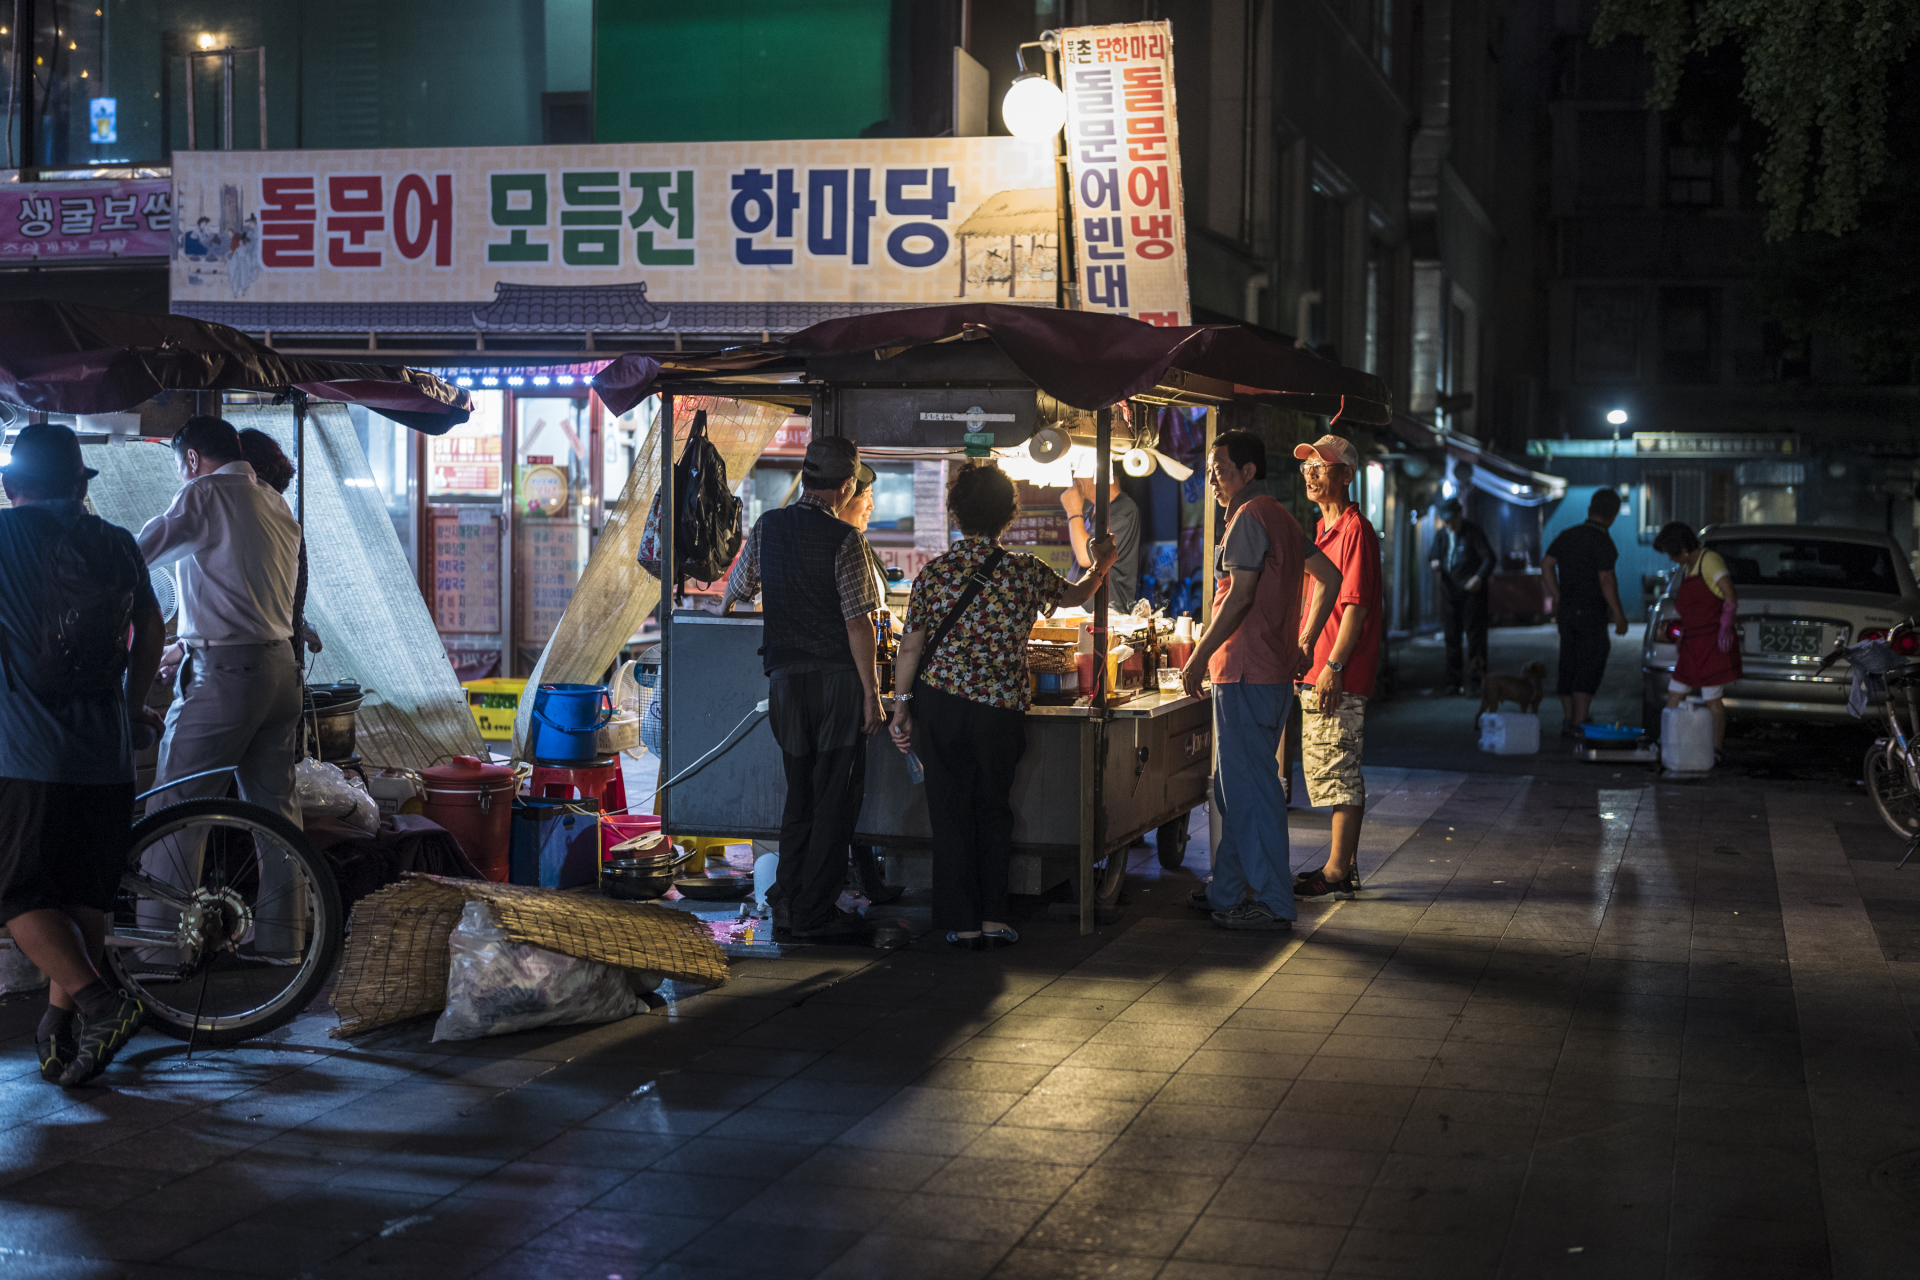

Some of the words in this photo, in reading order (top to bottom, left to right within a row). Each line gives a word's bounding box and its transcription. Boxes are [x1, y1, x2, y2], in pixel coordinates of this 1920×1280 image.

[1096, 34, 1165, 63] 닭한마리
[260, 172, 453, 268] 돌문어
[488, 170, 694, 266] 모듬전
[731, 168, 956, 268] 한마당
[1075, 69, 1129, 318] 돌문어빈대
[1763, 633, 1817, 653] 2953
